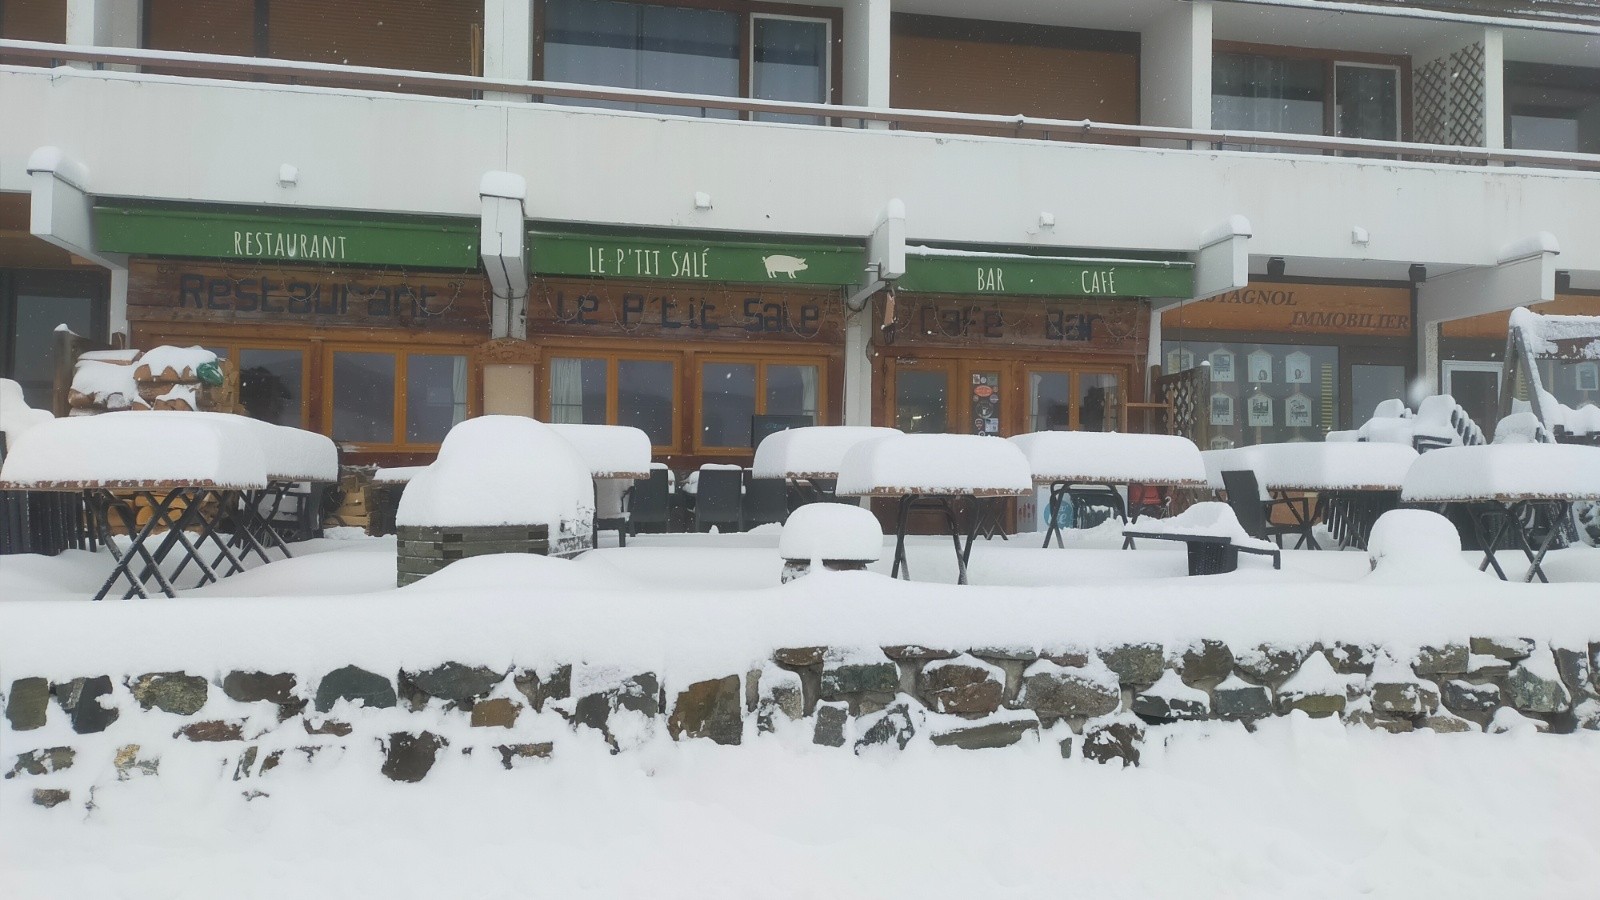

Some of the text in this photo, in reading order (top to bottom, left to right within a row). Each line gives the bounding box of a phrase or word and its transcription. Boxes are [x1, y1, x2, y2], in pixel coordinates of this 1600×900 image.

[234, 231, 347, 260] RESTAURANT
[589, 247, 710, 278] LE P'TIT SALÉ
[977, 268, 1005, 292] BAR
[1081, 267, 1117, 294] CAFÉ
[178, 273, 439, 319] Restaurant
[557, 290, 599, 325] Le
[1289, 310, 1409, 330] IMMOBILIER
